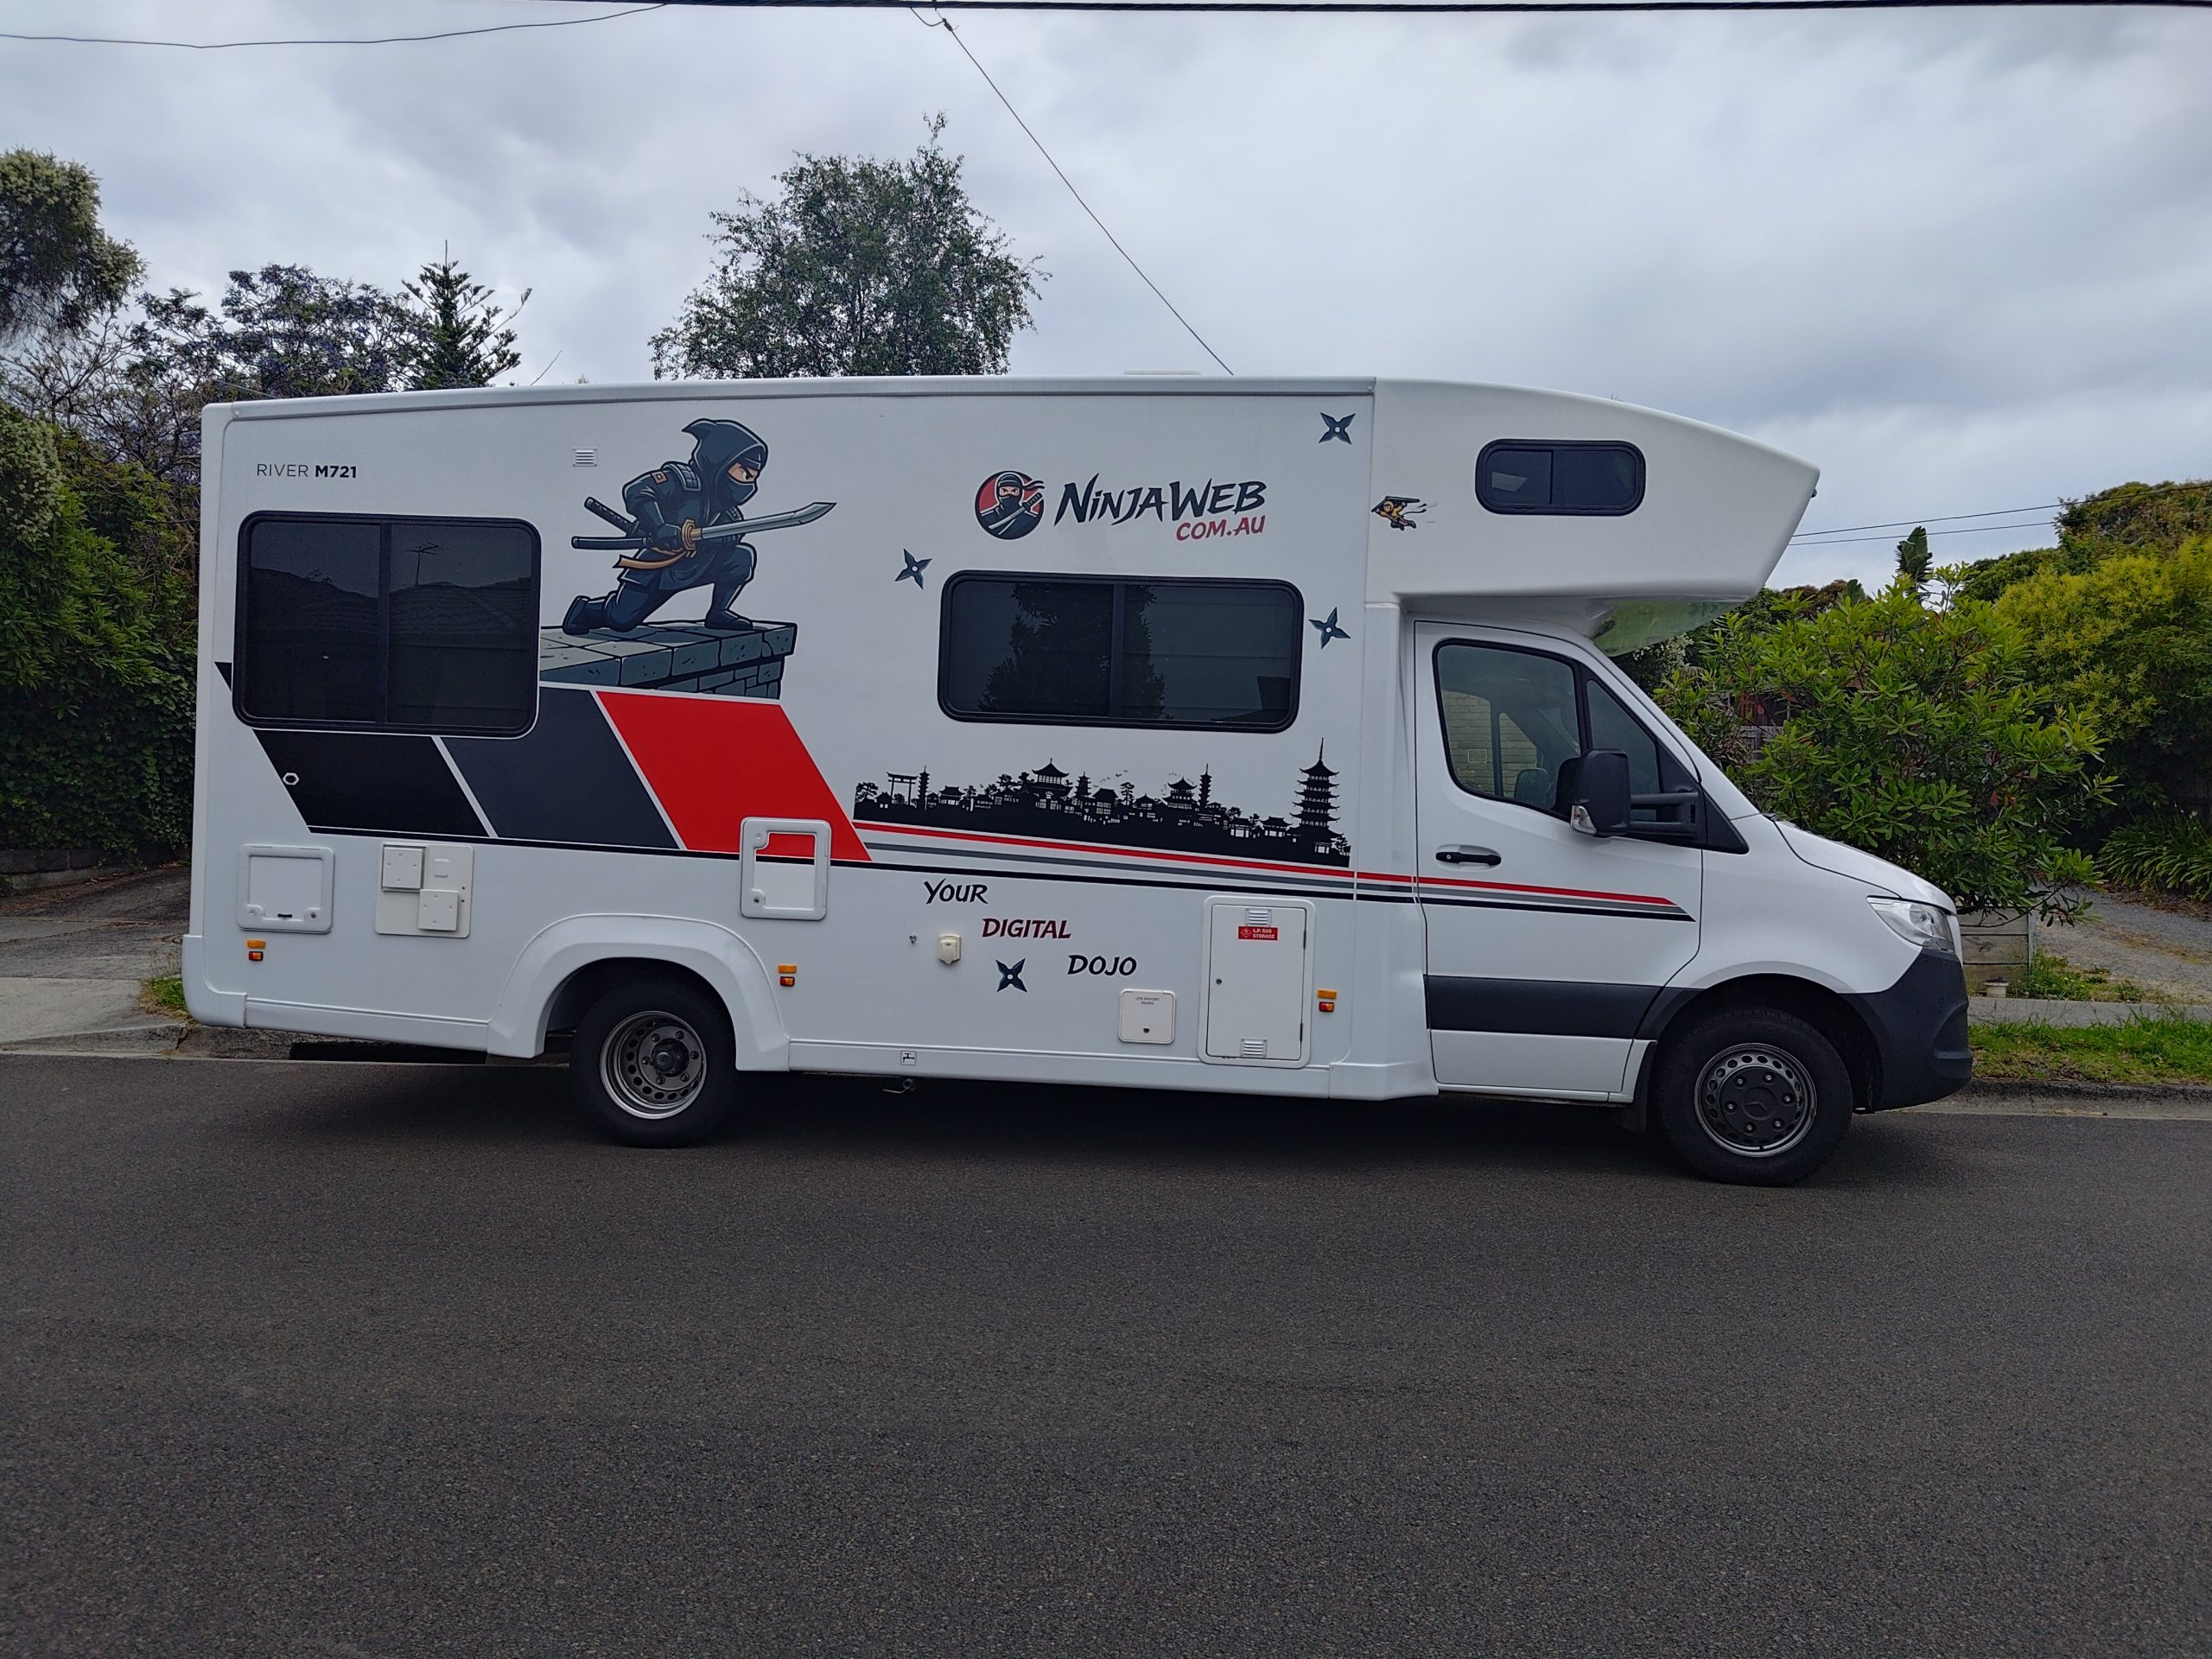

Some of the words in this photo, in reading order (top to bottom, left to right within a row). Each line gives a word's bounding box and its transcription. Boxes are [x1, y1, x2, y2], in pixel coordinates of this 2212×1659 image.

[257, 463, 308, 477] RIVER
[315, 465, 357, 478] M721
[1176, 515, 1266, 541] COM.AU
[924, 878, 988, 905] YOUR
[982, 918, 1071, 939] DIGITAL
[1067, 955, 1137, 976] DOJO
